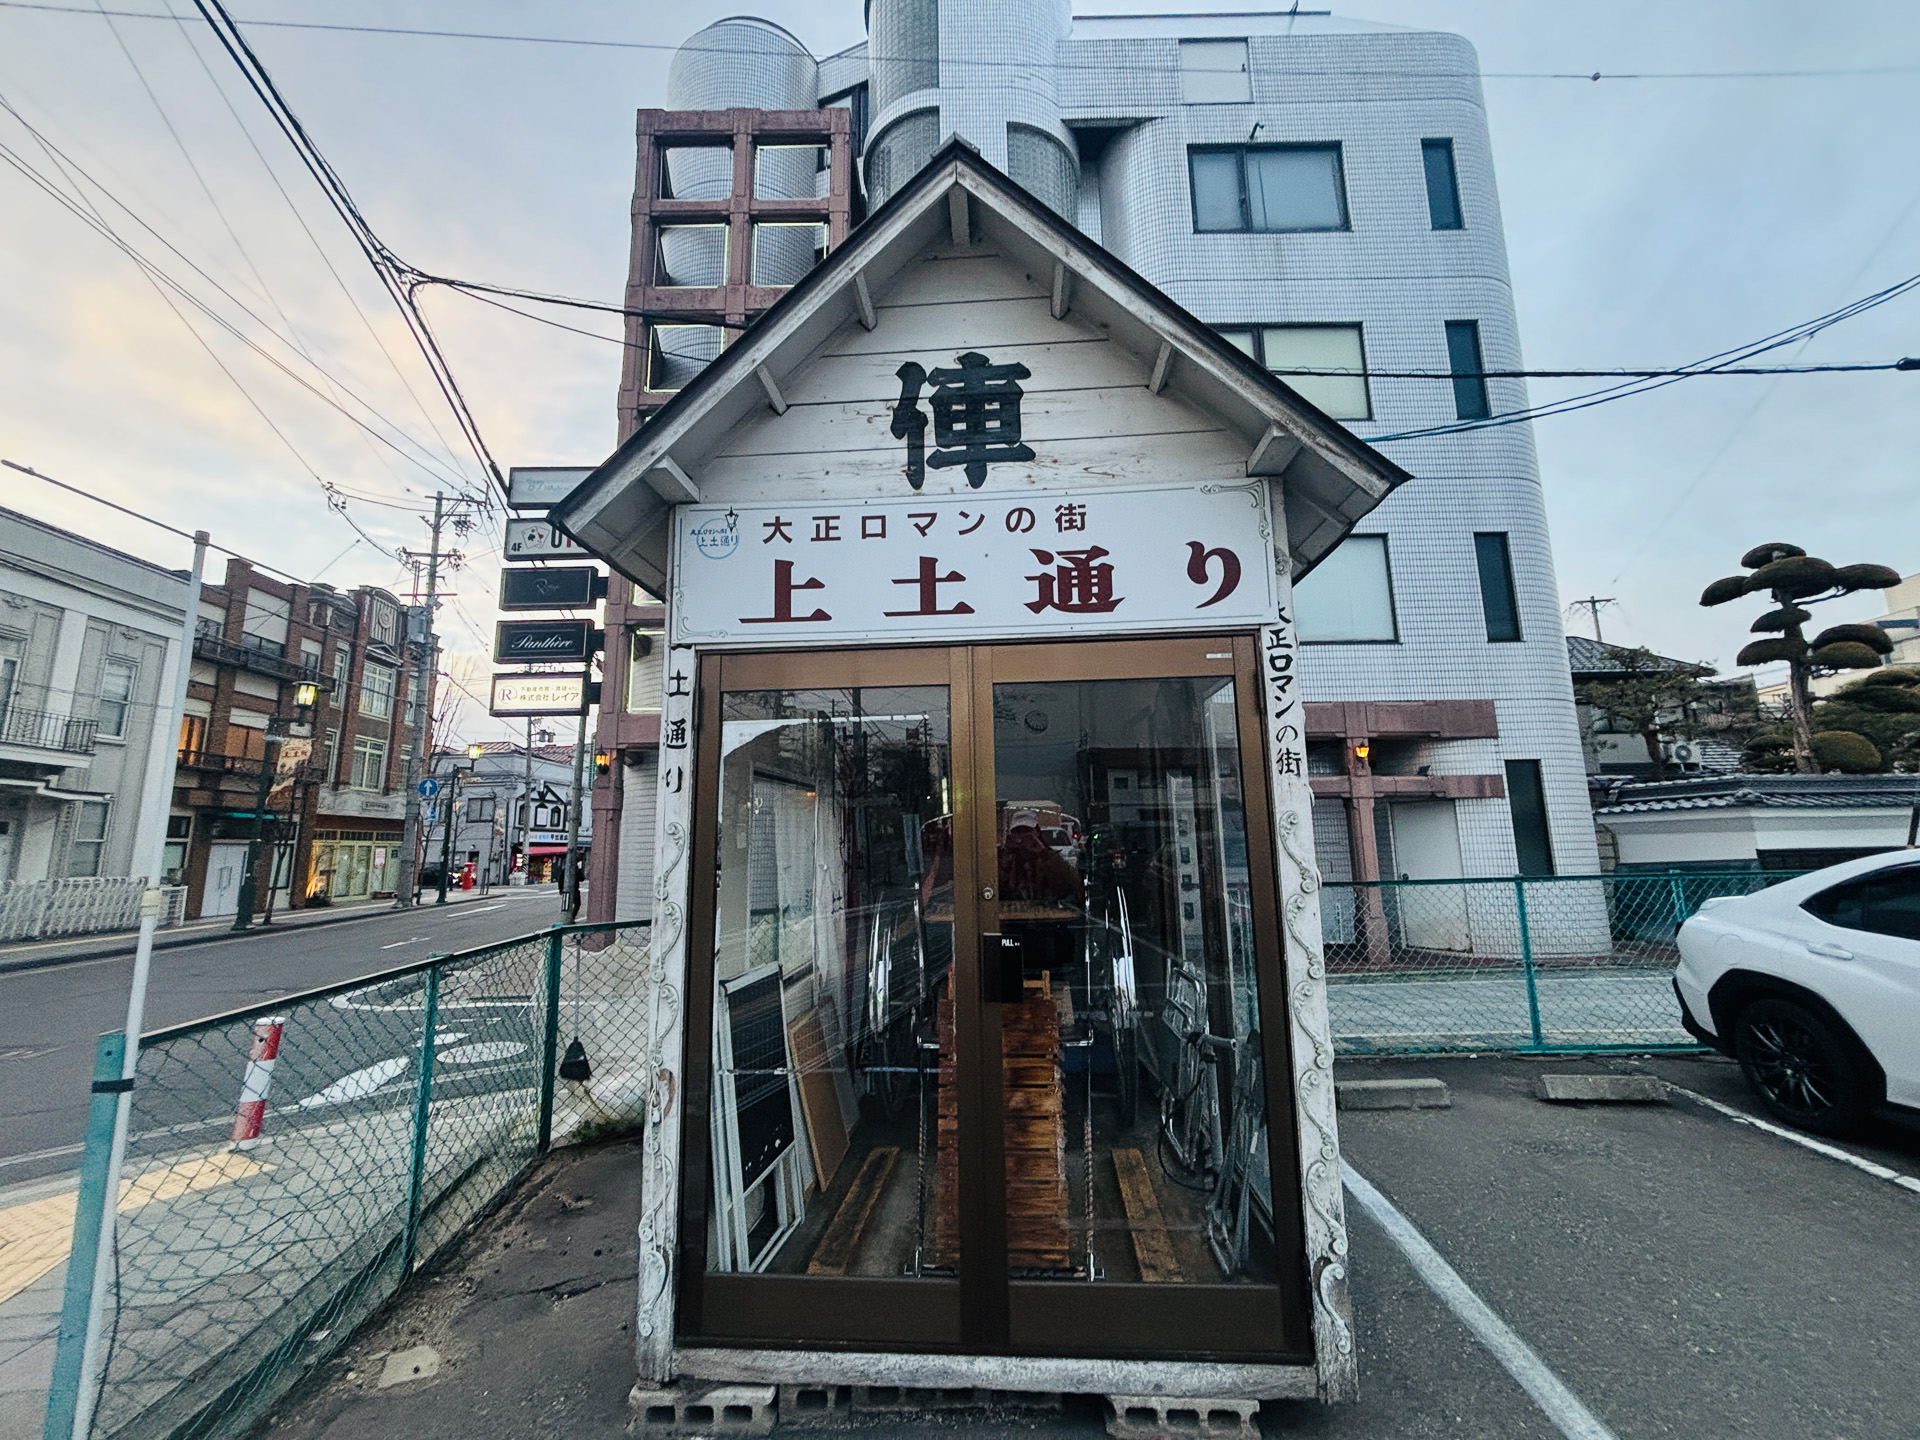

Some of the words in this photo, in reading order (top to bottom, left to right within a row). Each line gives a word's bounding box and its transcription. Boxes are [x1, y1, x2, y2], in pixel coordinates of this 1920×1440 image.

[762, 503, 1087, 544] 大正ロマンの街
[510, 543, 523, 552] 4F
[739, 540, 1242, 624] 上土通り
[519, 694, 550, 702] 株式会社
[551, 692, 580, 702] レイア
[1001, 938, 1014, 947] PULL
